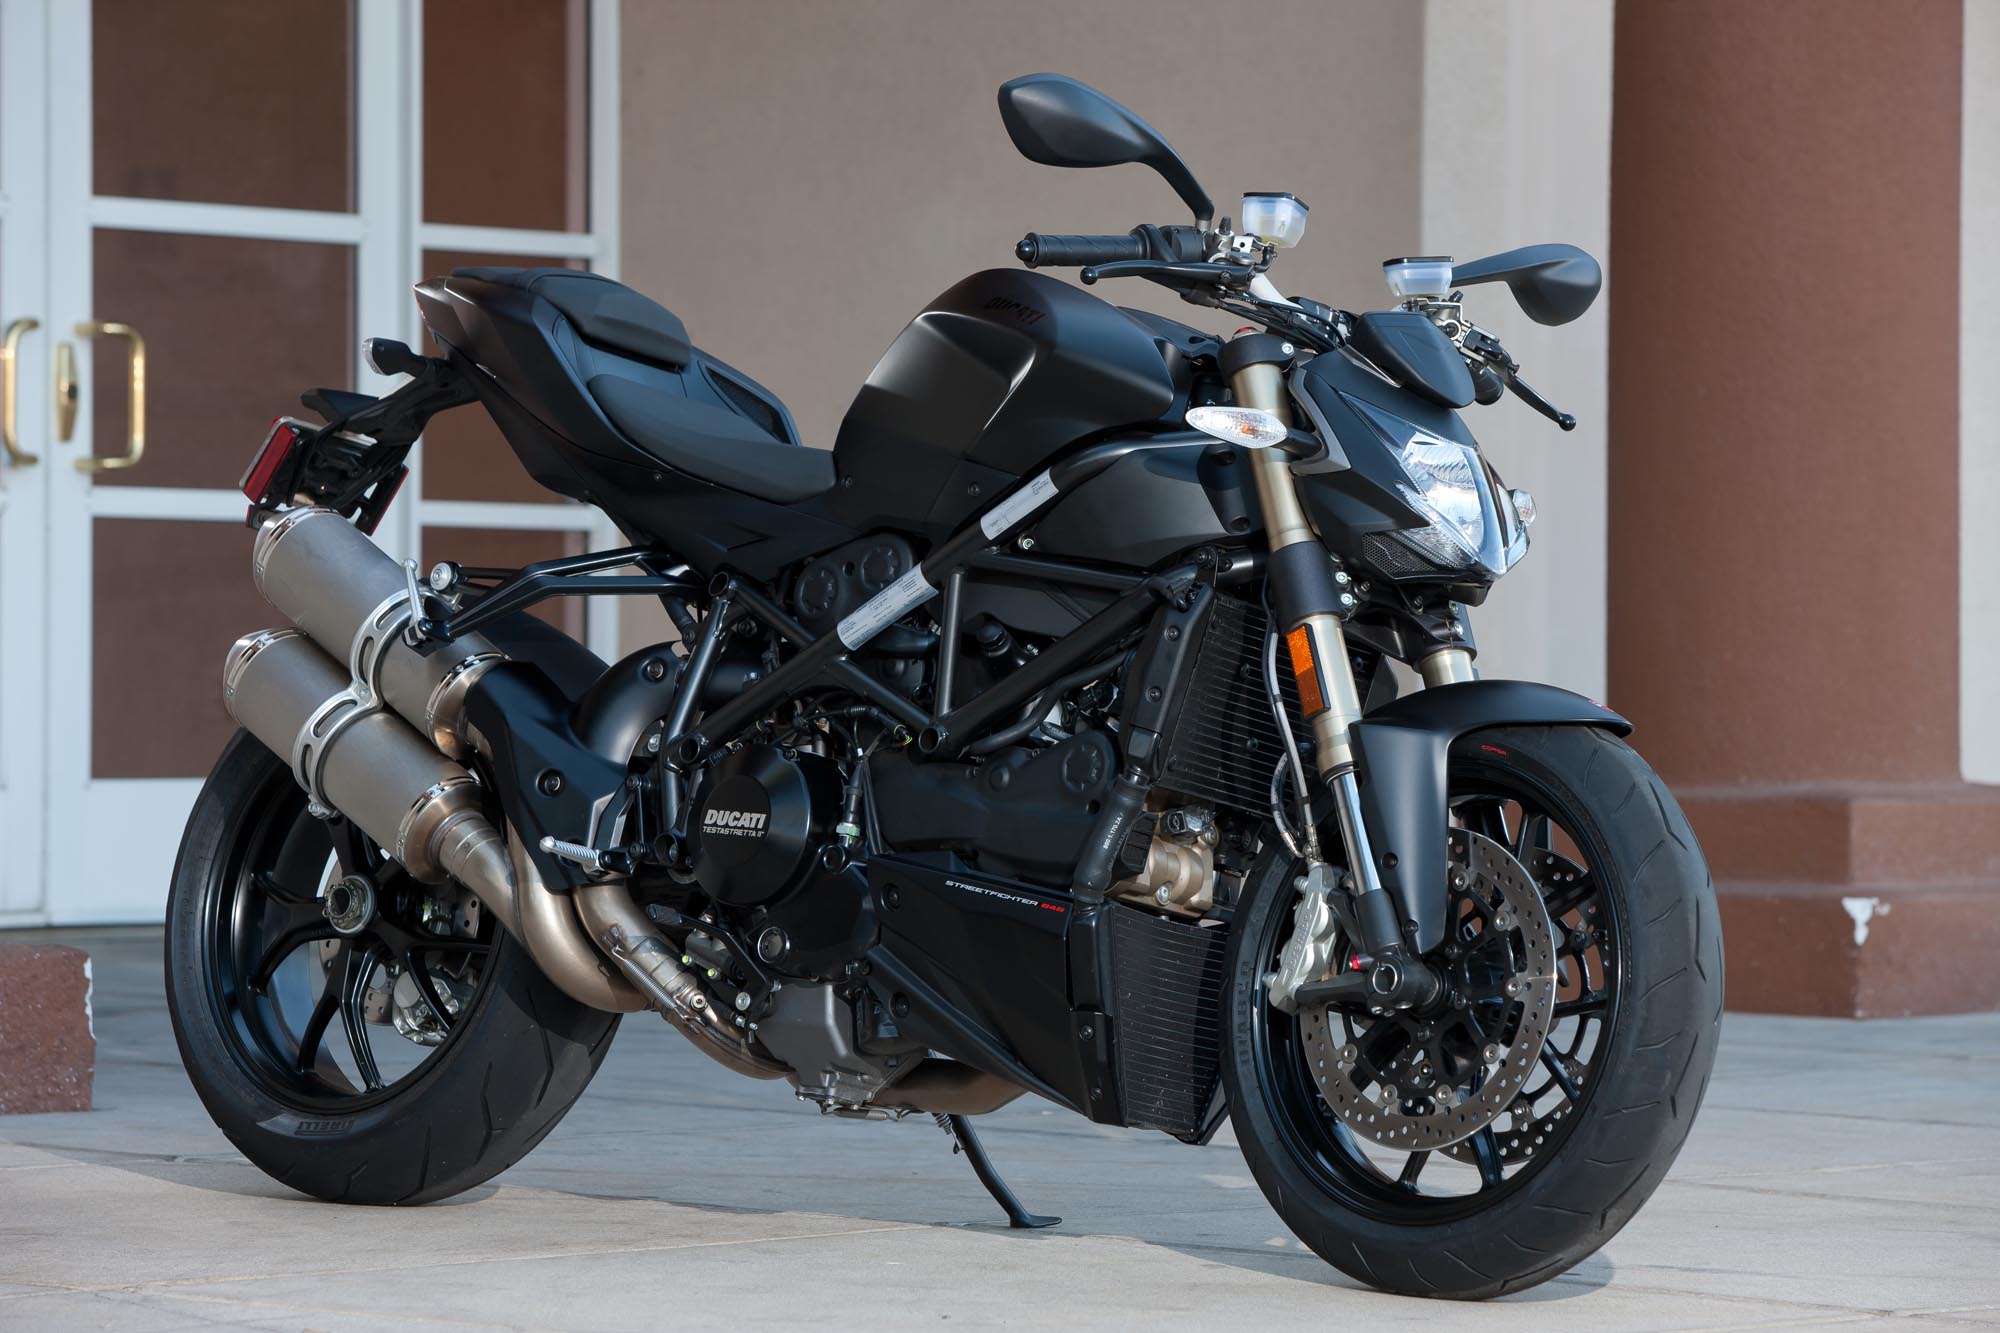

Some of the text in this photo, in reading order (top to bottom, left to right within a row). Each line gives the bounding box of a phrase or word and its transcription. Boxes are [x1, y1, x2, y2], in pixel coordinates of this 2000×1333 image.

[704, 808, 767, 829] DUCATI
[702, 826, 756, 837] TESTASTRETTA
[945, 880, 1039, 906] STREETFIGHTER
